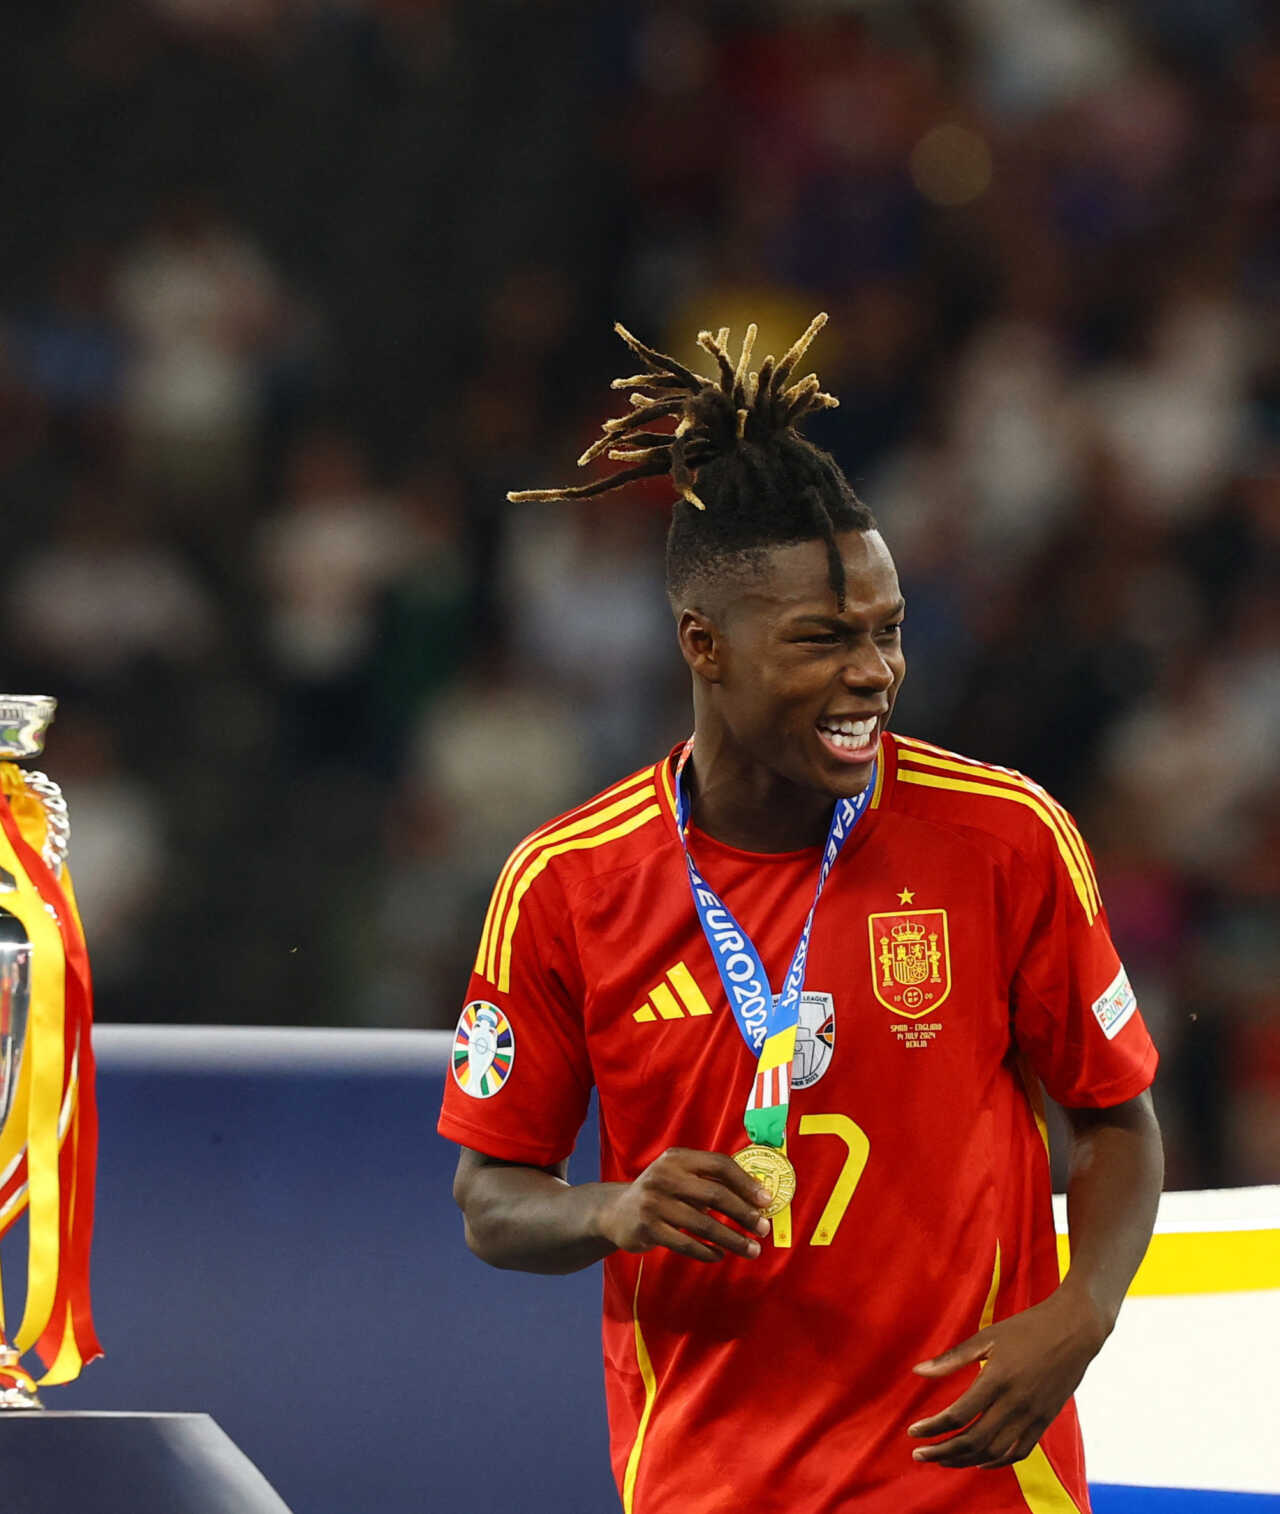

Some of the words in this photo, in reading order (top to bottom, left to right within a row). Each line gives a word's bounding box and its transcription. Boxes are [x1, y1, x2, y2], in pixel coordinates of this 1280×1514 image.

[696, 887, 769, 1049] EURO2024
[915, 1023, 942, 1031] ENGLAND
[905, 1032, 918, 1040] JULY
[920, 1031, 936, 1040] 2024
[906, 1040, 928, 1048] BERLIN
